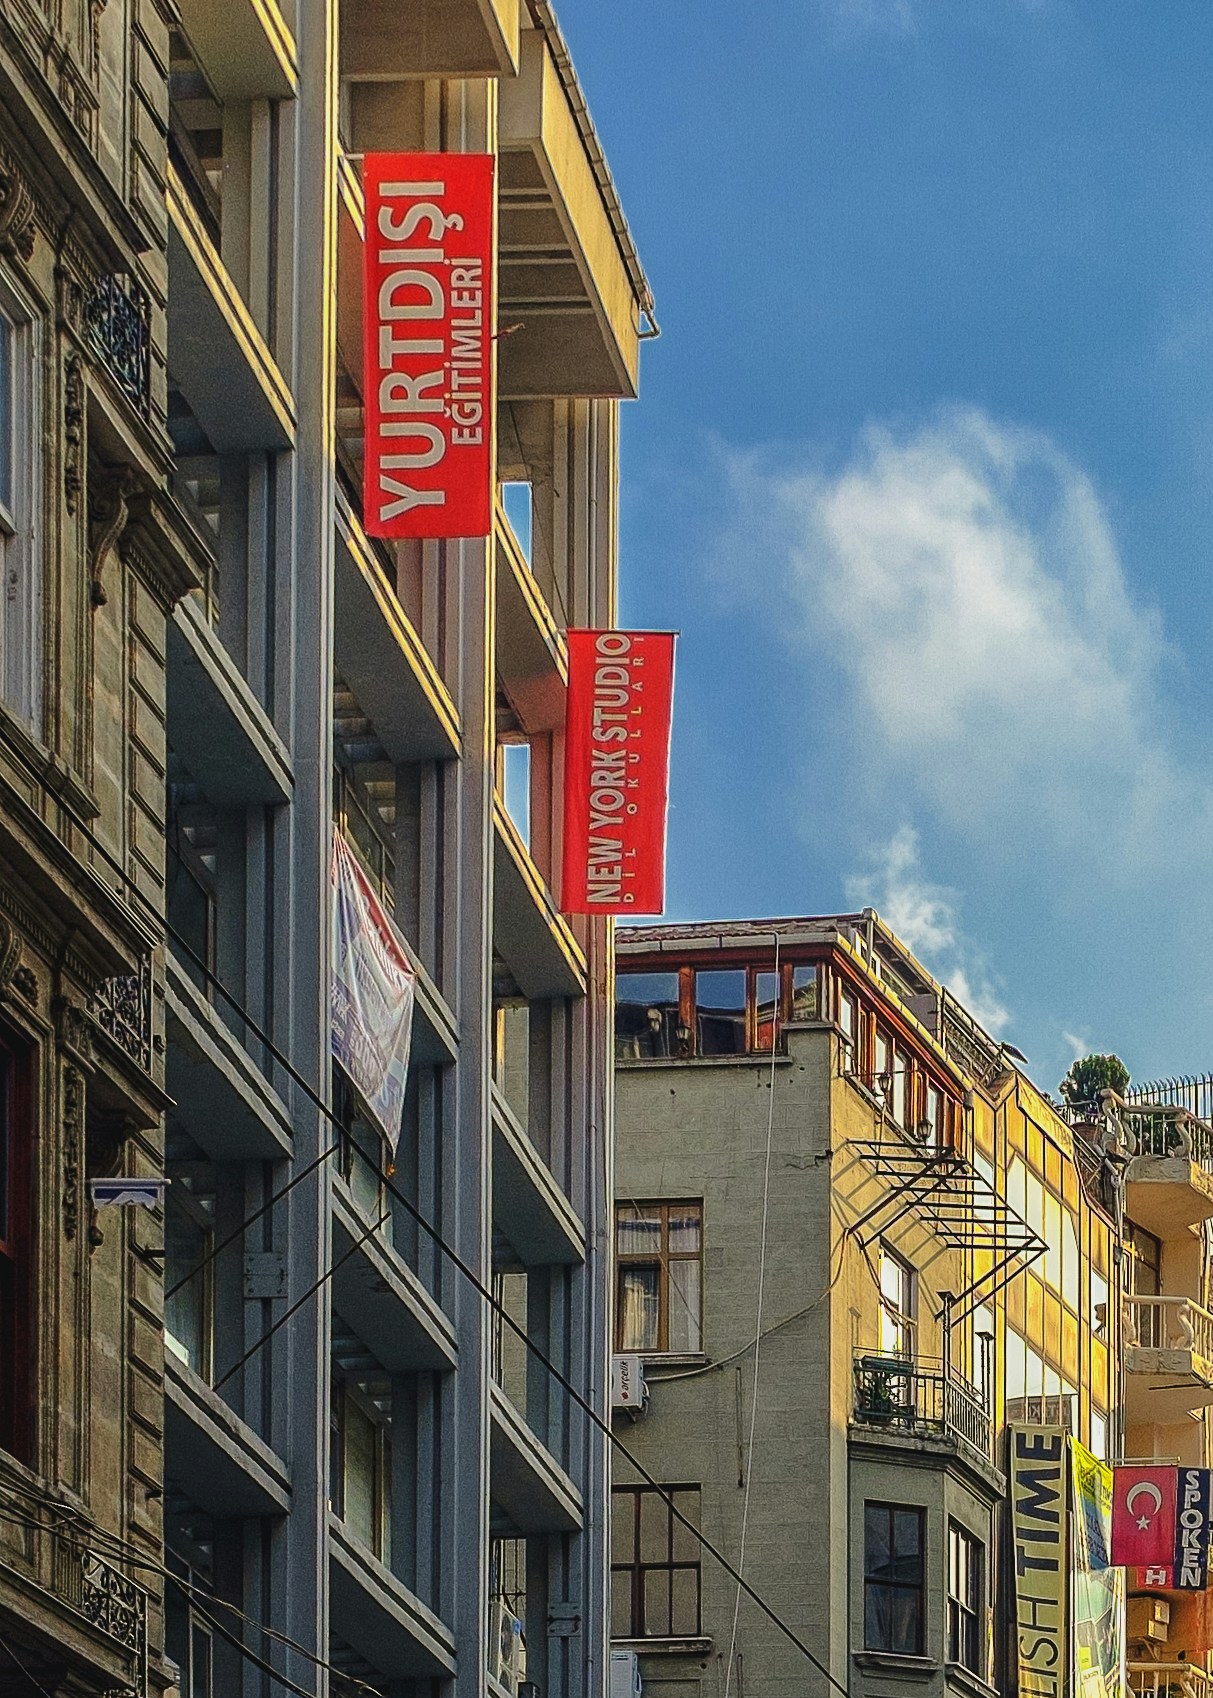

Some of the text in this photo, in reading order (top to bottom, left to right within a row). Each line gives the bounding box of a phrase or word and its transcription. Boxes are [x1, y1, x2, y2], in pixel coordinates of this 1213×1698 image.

[378, 181, 464, 521] YURTDIŞI
[444, 258, 482, 445] EĞİTİMLERİ
[587, 633, 631, 903] NEW YORK STUDIO
[627, 637, 644, 815] OKULLARI
[1016, 1432, 1061, 1577] TIME
[1180, 1470, 1204, 1587] SPOKEN
